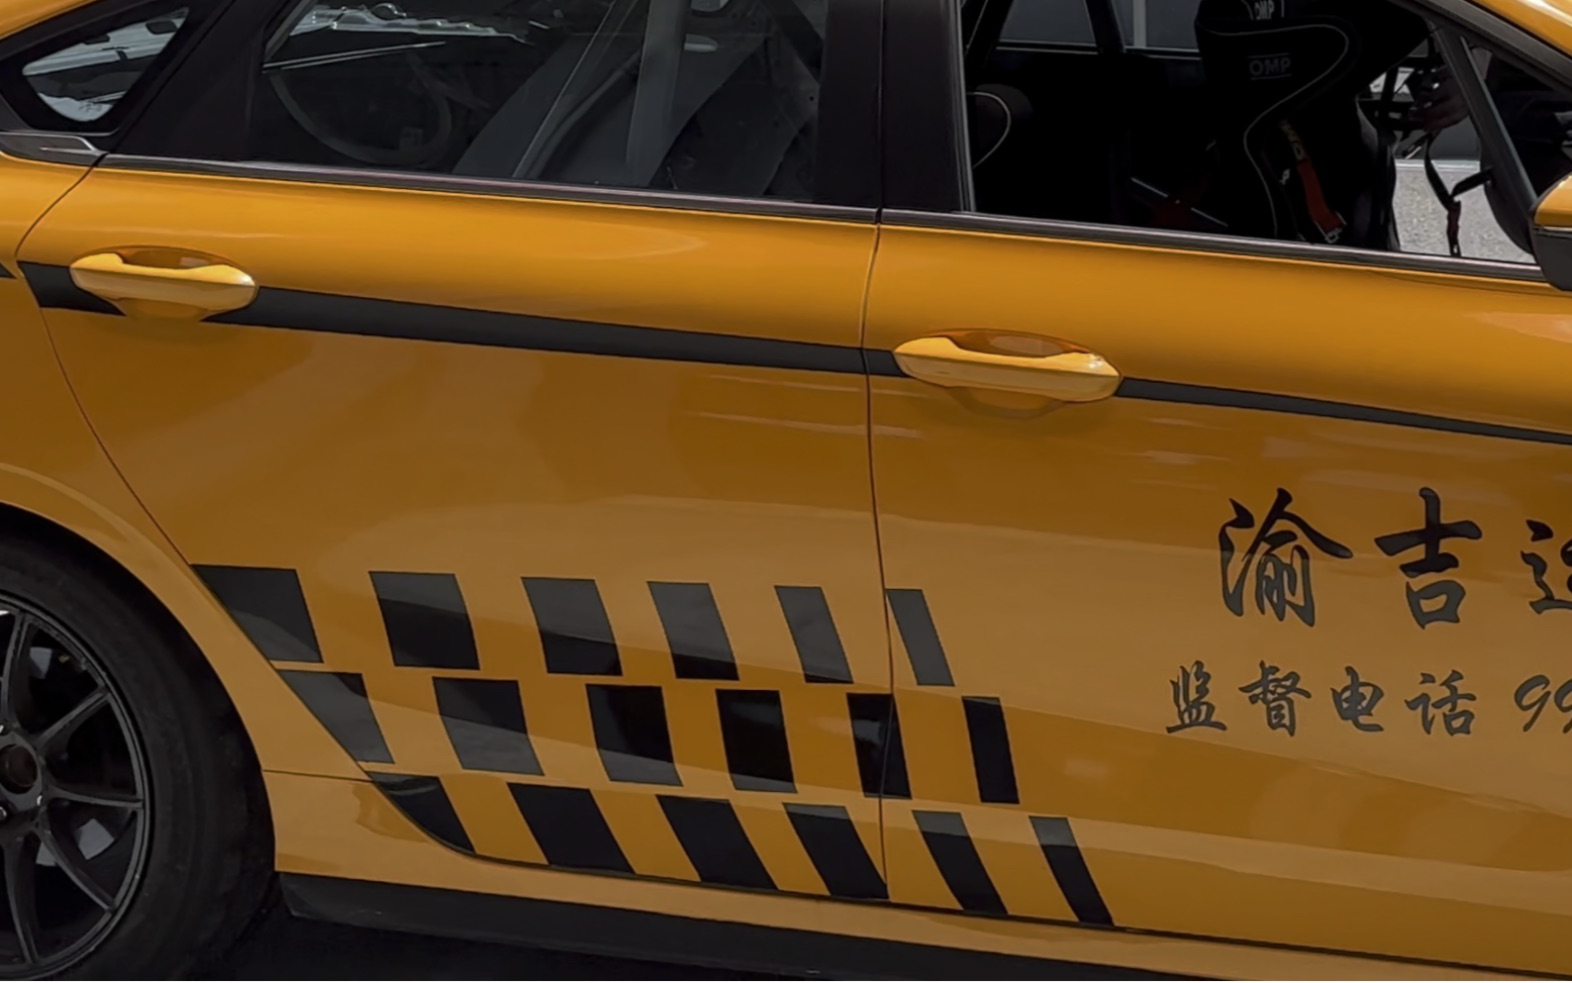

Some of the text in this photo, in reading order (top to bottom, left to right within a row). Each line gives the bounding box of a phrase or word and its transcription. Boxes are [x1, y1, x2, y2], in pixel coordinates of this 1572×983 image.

[1249, 57, 1291, 76] OMP
[1166, 660, 1477, 737] 监督电话
